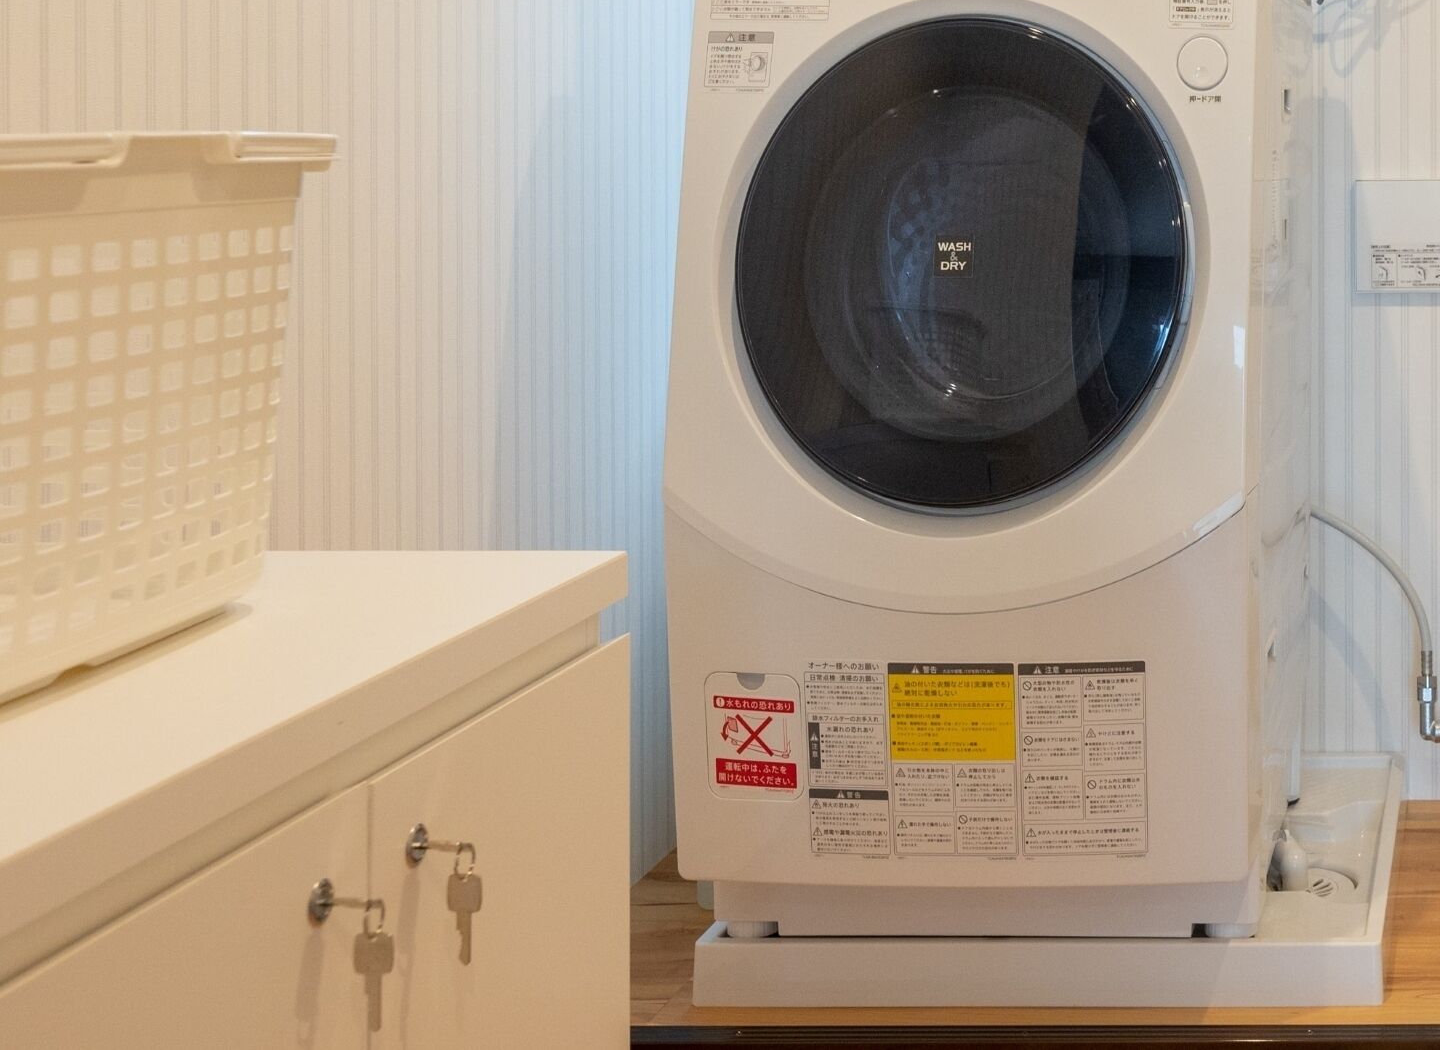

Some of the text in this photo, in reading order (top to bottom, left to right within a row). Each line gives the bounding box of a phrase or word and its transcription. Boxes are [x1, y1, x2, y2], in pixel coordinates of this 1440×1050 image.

[738, 34, 756, 42] 注意
[937, 241, 972, 252] WASH
[950, 251, 958, 261] &
[940, 261, 967, 270] DRY
[808, 662, 880, 670] オーナー様へのお願い
[923, 666, 936, 674] 警告
[1045, 666, 1060, 674] 注意
[726, 698, 792, 712] 水もれの恐れあり
[725, 762, 787, 774] 運転中は、ふたを
[718, 772, 795, 786] 開けないでください。
